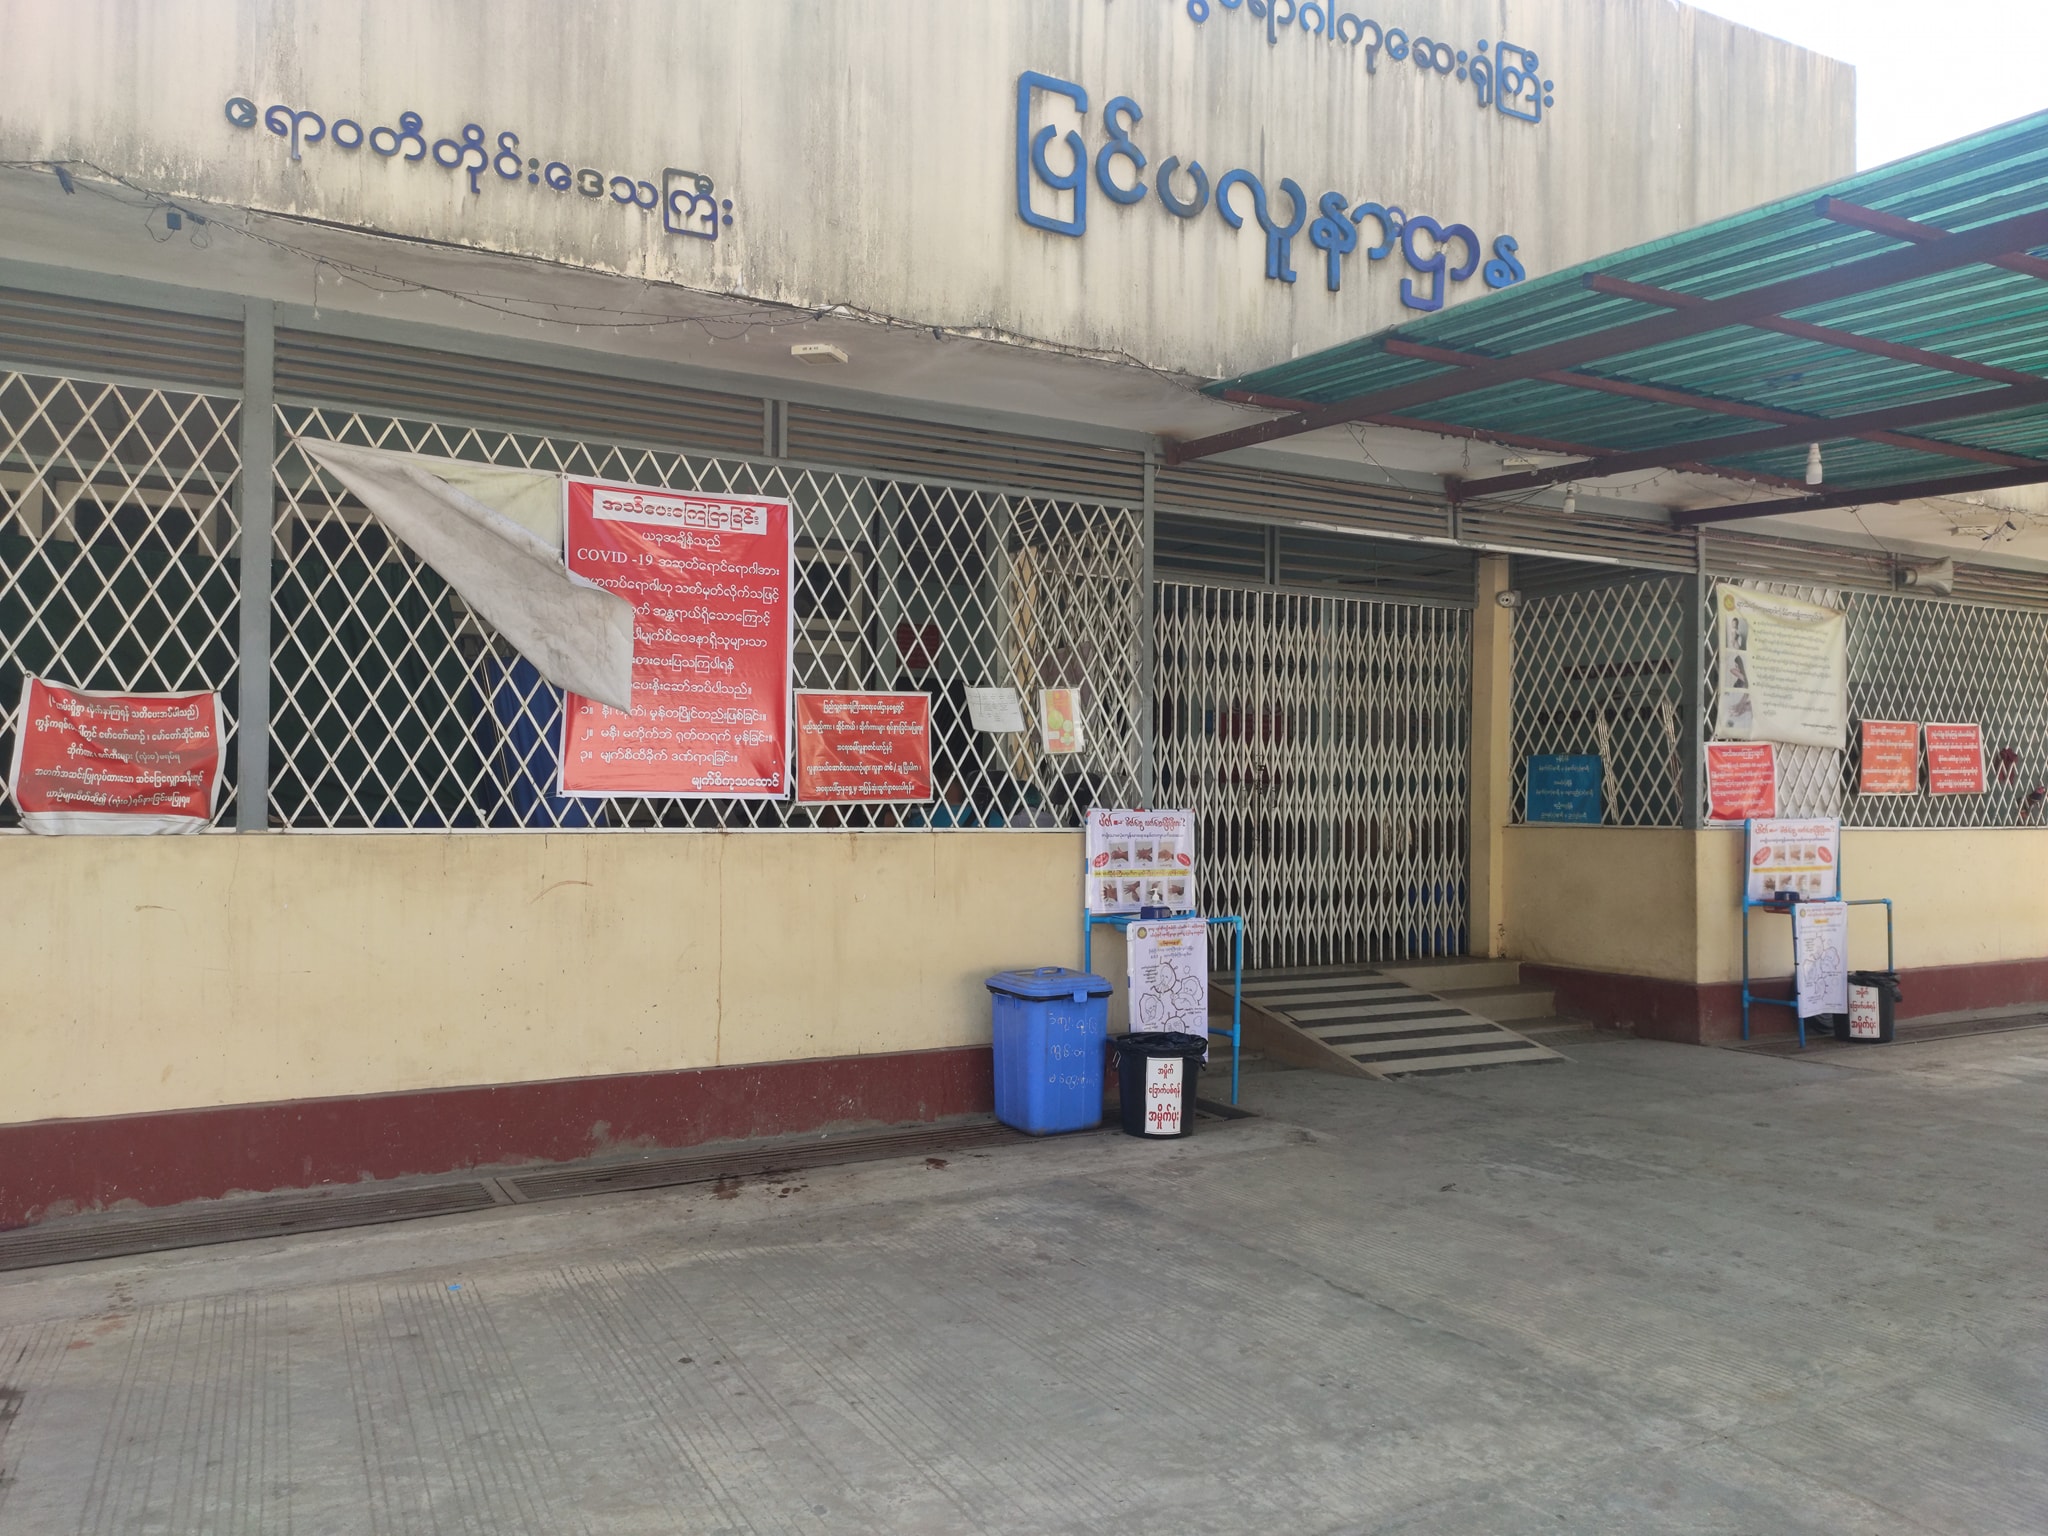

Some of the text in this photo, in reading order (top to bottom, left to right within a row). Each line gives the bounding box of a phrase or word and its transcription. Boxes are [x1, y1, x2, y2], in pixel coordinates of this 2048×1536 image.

[642, 531, 721, 551] ယခုအချိန်သည်
[577, 548, 628, 564] COVID
